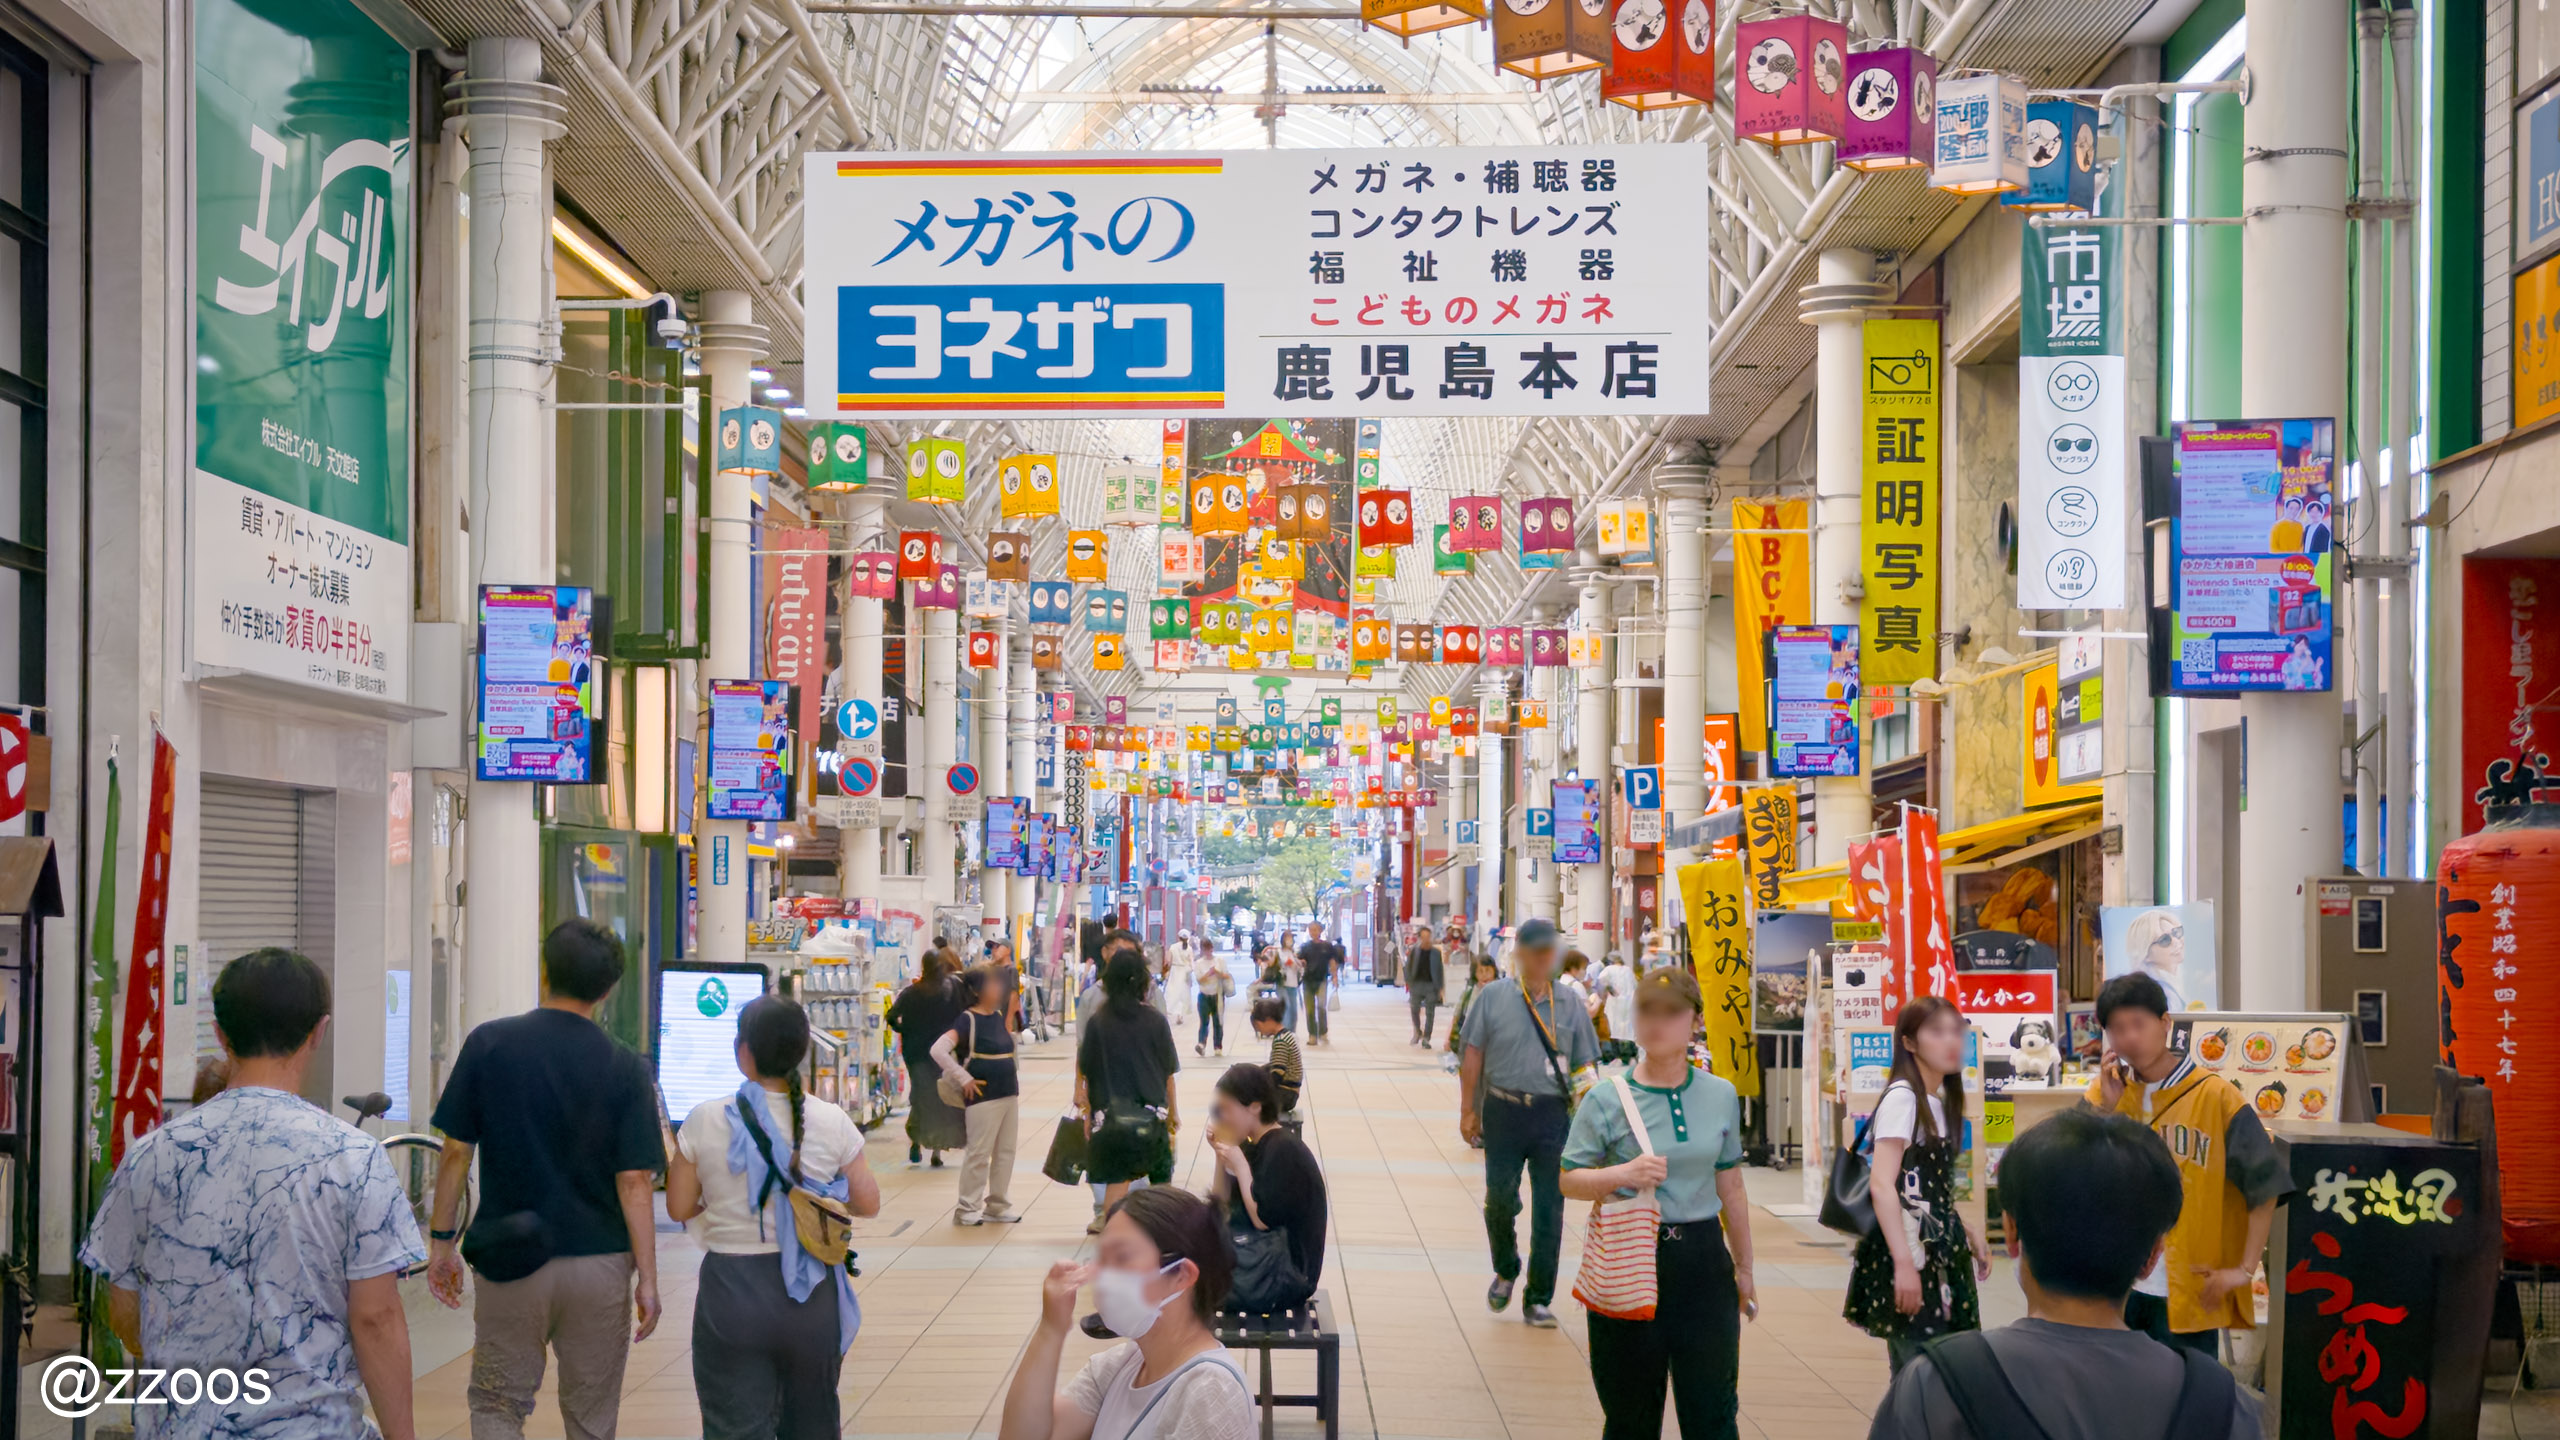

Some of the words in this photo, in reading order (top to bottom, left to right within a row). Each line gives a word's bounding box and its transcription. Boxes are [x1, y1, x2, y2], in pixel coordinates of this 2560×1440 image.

[1310, 159, 1617, 194] メガネ・補聴器
[872, 190, 1195, 272] メガネの
[1310, 201, 1621, 239] コンタクトレンズ
[215, 124, 395, 352] エイブル
[1309, 249, 1615, 285] 福祉機器
[1310, 291, 1615, 326] こどものメガネ
[869, 296, 1192, 379] ヨネザワ
[1273, 341, 1659, 401] 鹿児島本店
[2055, 455, 2090, 464] サングラス
[1873, 416, 1927, 655] 証明写真
[2056, 519, 2089, 528] コンタクト
[267, 551, 350, 606] オーナー様大募集
[1633, 771, 1653, 806] P
[1460, 823, 1471, 842] P
[1533, 810, 1549, 835] P
[1749, 795, 1787, 910] さつま
[2329, 885, 2350, 894] AED
[2490, 882, 2518, 1083] 創業昭和四十七年
[1834, 996, 1881, 1007] カメラ買取
[1853, 1037, 1890, 1047] BEST
[1853, 1048, 1890, 1059] PRICE
[2286, 1230, 2427, 1440] らーめん
